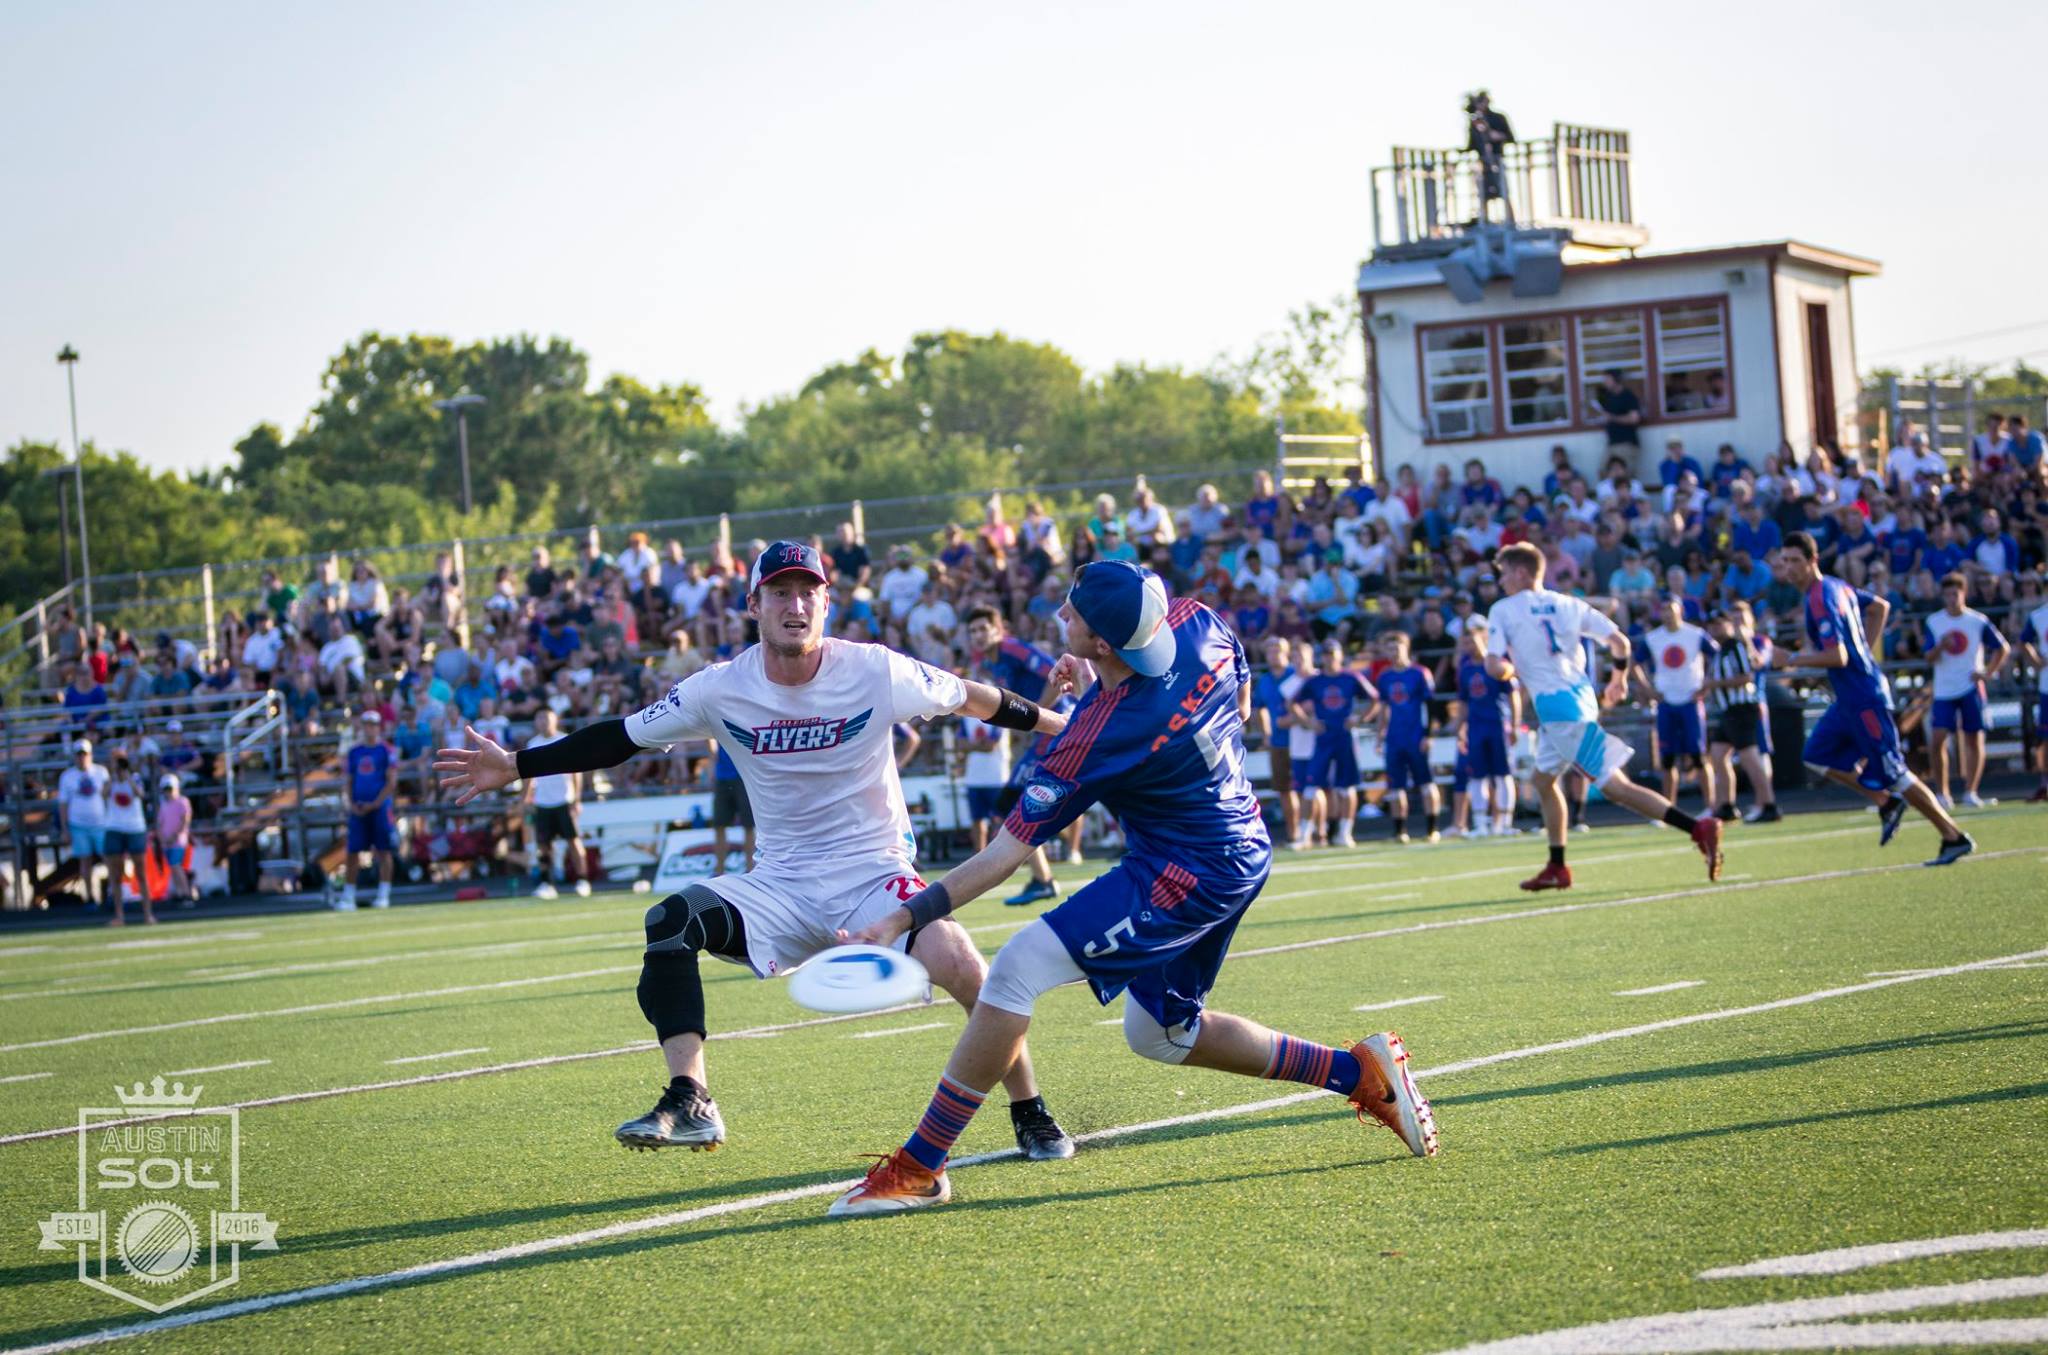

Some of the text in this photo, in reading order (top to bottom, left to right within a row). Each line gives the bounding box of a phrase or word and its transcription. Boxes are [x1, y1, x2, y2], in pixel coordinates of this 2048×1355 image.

[1541, 618, 1563, 655] 1
[756, 722, 841, 753] FLYERS
[1083, 916, 1136, 958] 5
